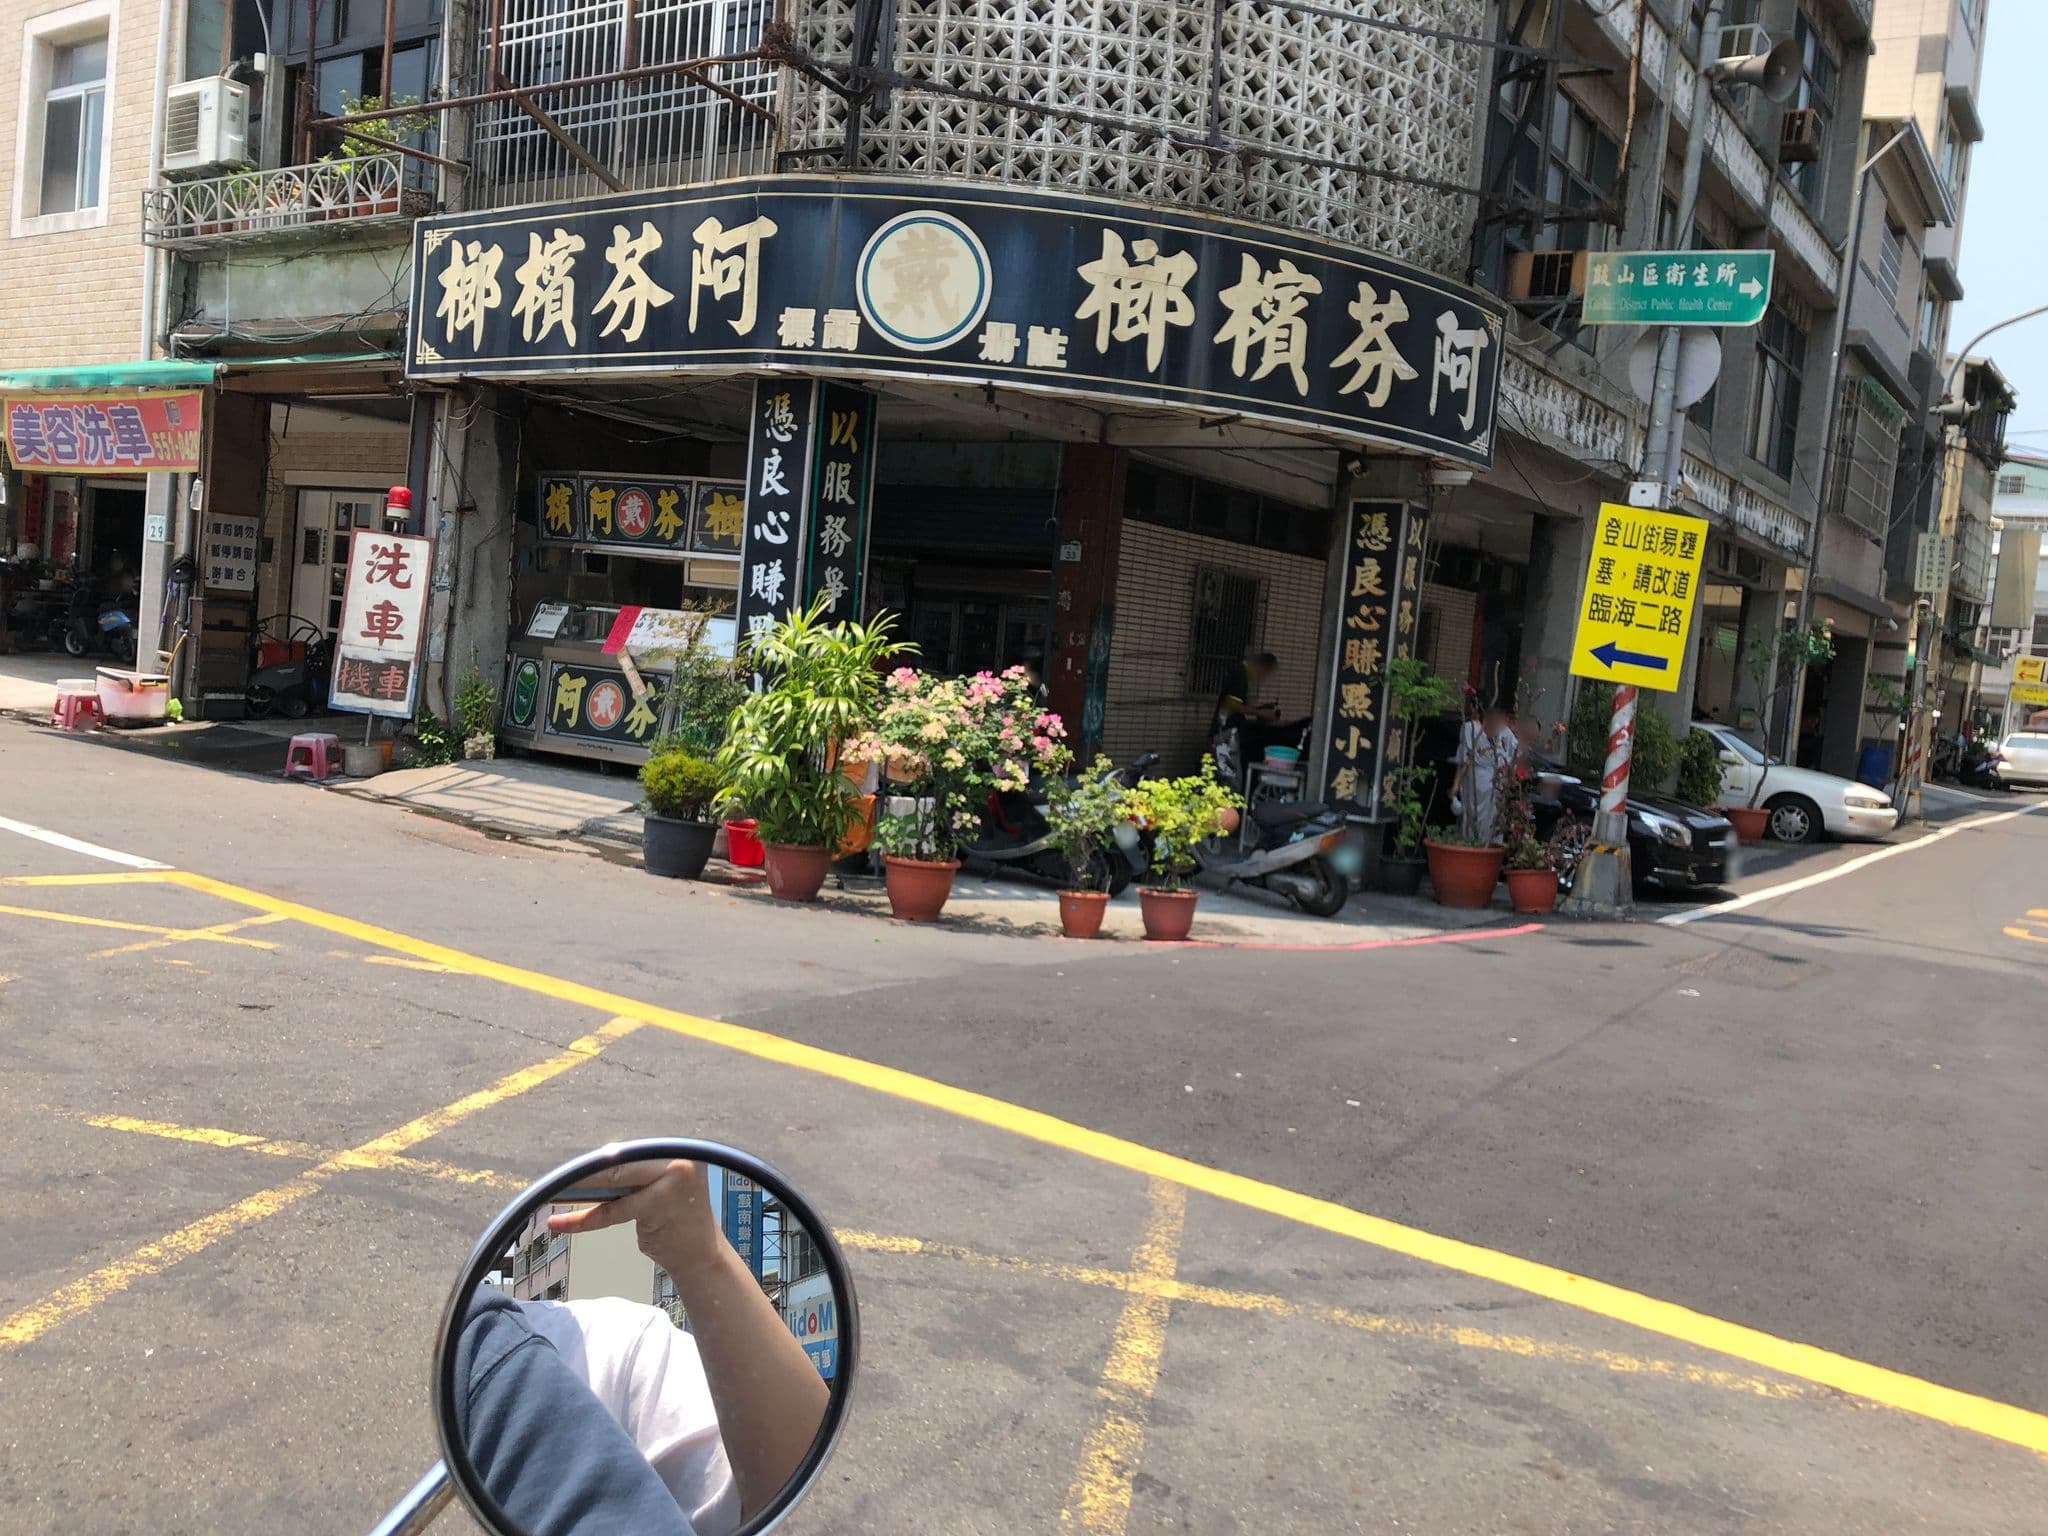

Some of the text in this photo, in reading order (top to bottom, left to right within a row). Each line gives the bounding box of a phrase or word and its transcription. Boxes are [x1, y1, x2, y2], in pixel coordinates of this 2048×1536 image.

[1592, 261, 1738, 287] 鼓山區衛生所
[11, 403, 153, 464] 美容洗車
[150, 525, 163, 538] 29
[1603, 517, 1699, 560] 登山街易壅
[361, 543, 413, 646] 洗車
[1588, 592, 1683, 636] 臨海二路
[338, 659, 407, 698] 機車
